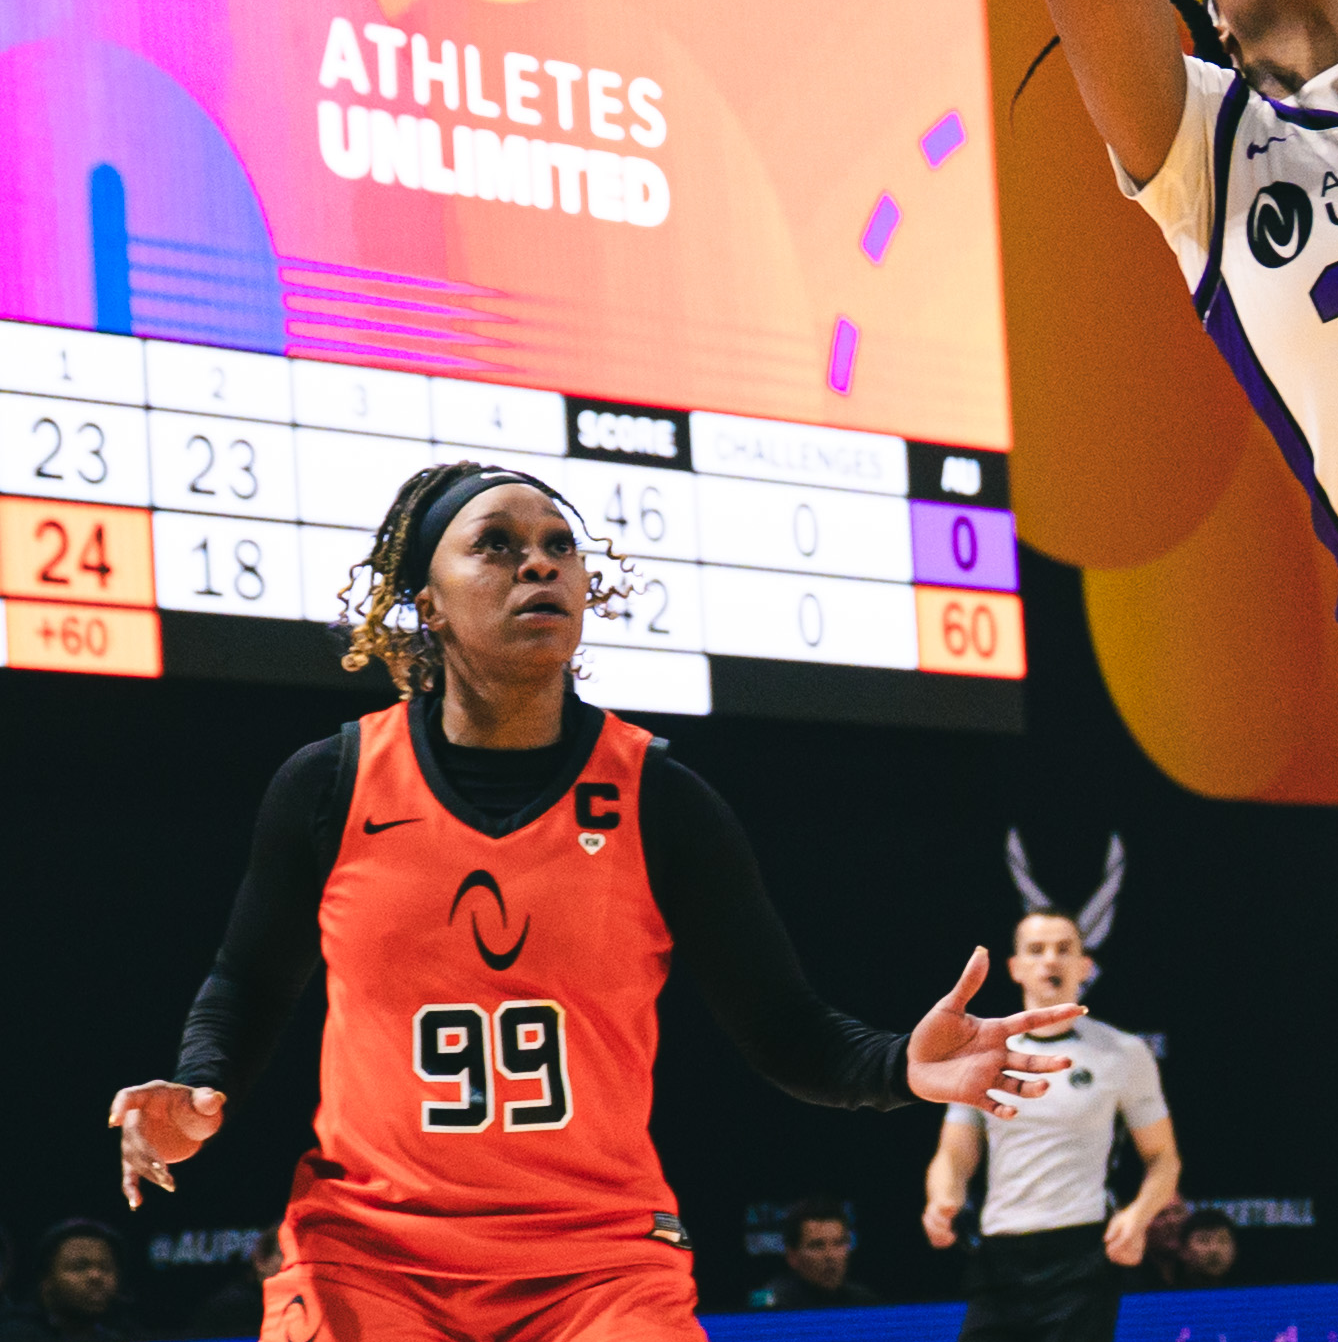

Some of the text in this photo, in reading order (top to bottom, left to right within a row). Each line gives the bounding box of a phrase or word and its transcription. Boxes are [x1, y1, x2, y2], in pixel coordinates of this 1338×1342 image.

[317, 16, 668, 148] ATHLETES
[317, 99, 670, 228] UNLIMITED
[212, 366, 226, 400] 2
[576, 409, 679, 459] SCORE
[712, 430, 884, 481] CHALLENGES
[32, 417, 108, 485] 23
[186, 434, 259, 500] 23
[604, 482, 666, 543] 46
[952, 515, 978, 571] 0
[34, 520, 112, 589] 24
[192, 537, 265, 600] 18
[942, 600, 999, 659] 60
[37, 615, 108, 658] +60
[574, 782, 621, 830] C
[412, 1000, 574, 1133] 99
